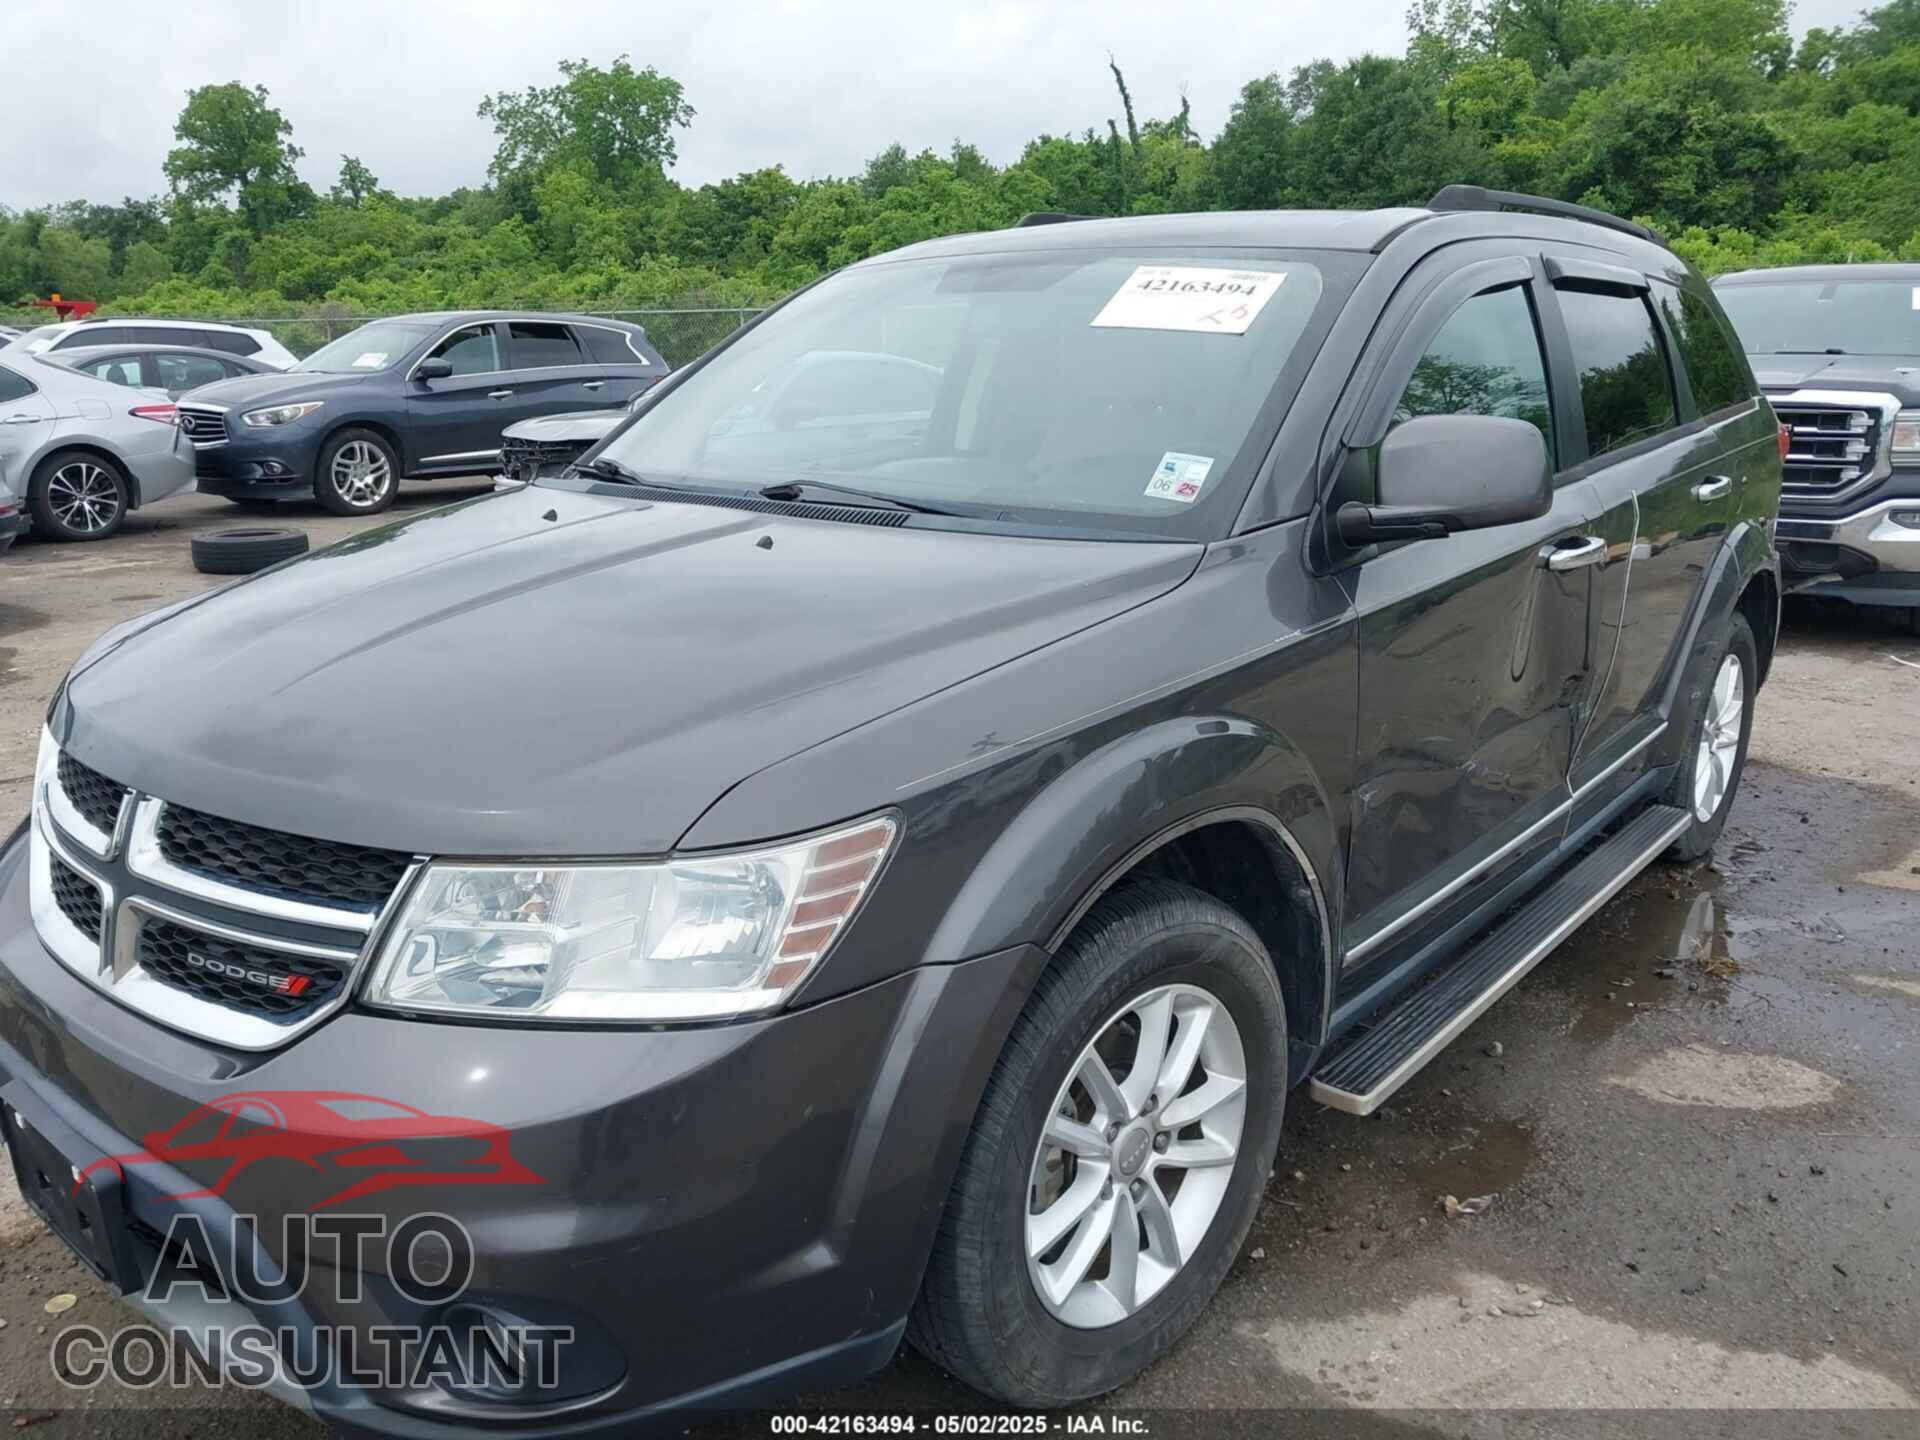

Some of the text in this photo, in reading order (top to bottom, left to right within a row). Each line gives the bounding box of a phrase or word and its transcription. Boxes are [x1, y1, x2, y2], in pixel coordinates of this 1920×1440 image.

[1136, 278, 1257, 297] 42163494
[1153, 479, 1199, 496] 06 25
[187, 952, 290, 990] DODGE
